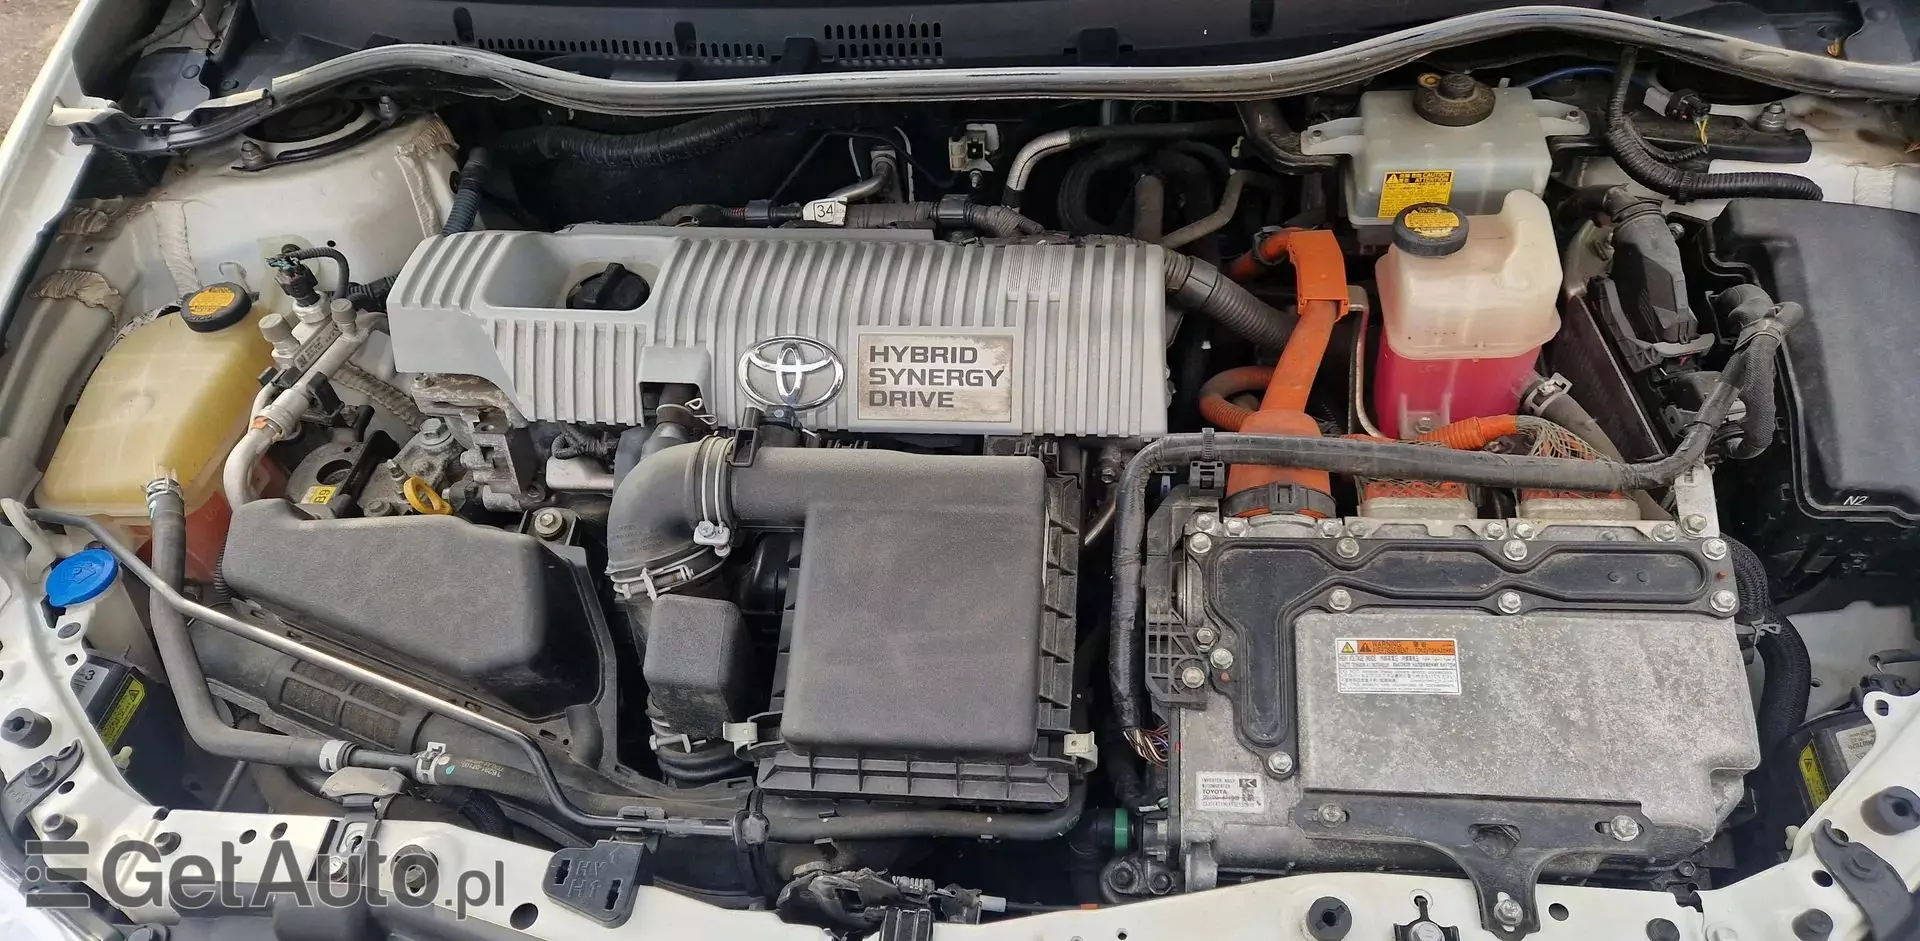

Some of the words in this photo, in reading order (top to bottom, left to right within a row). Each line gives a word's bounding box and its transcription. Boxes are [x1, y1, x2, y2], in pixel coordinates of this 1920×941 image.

[816, 204, 833, 218] 34
[869, 345, 978, 363] HYBRID
[869, 367, 1004, 387] SYNERGY
[869, 390, 955, 408] DRIVE
[1843, 495, 1868, 506] N2
[84, 669, 96, 681] 3
